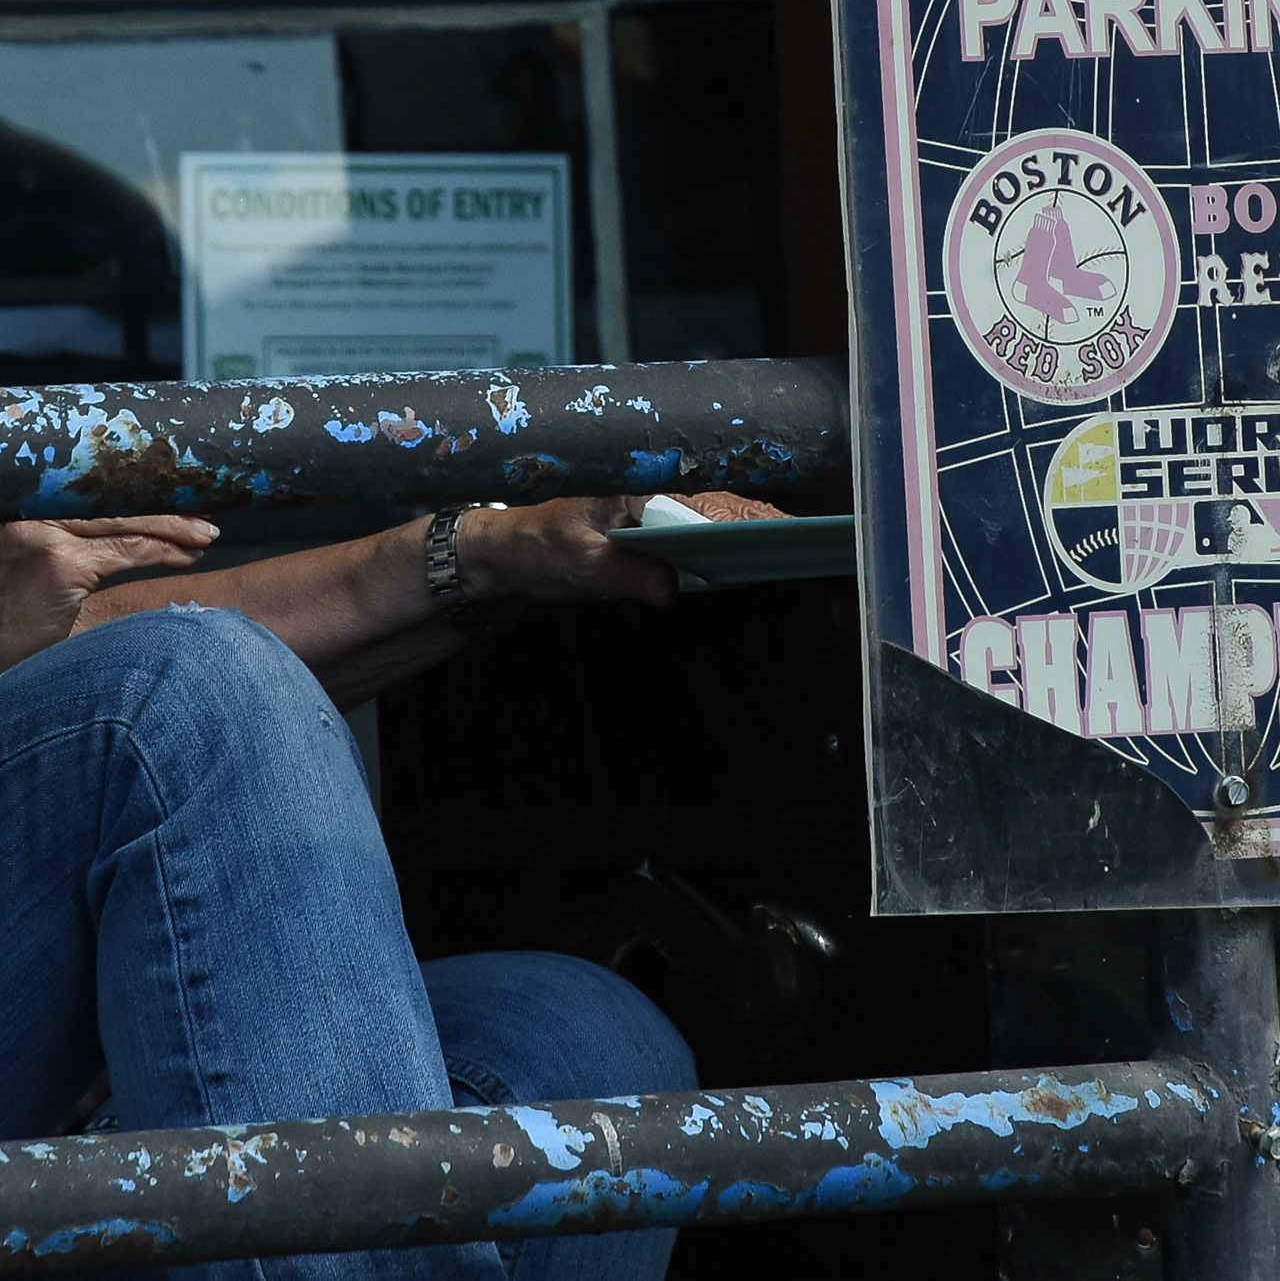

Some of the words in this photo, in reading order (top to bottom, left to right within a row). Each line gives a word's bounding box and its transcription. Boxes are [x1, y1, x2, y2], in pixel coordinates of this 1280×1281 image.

[208, 186, 398, 220] CONDITIONS
[404, 186, 448, 220] OF
[451, 185, 545, 220] ENTRY
[969, 152, 1147, 237] BOSTON
[1086, 306, 1105, 318] TM
[982, 314, 1060, 383] RED
[1078, 304, 1151, 383] SOX
